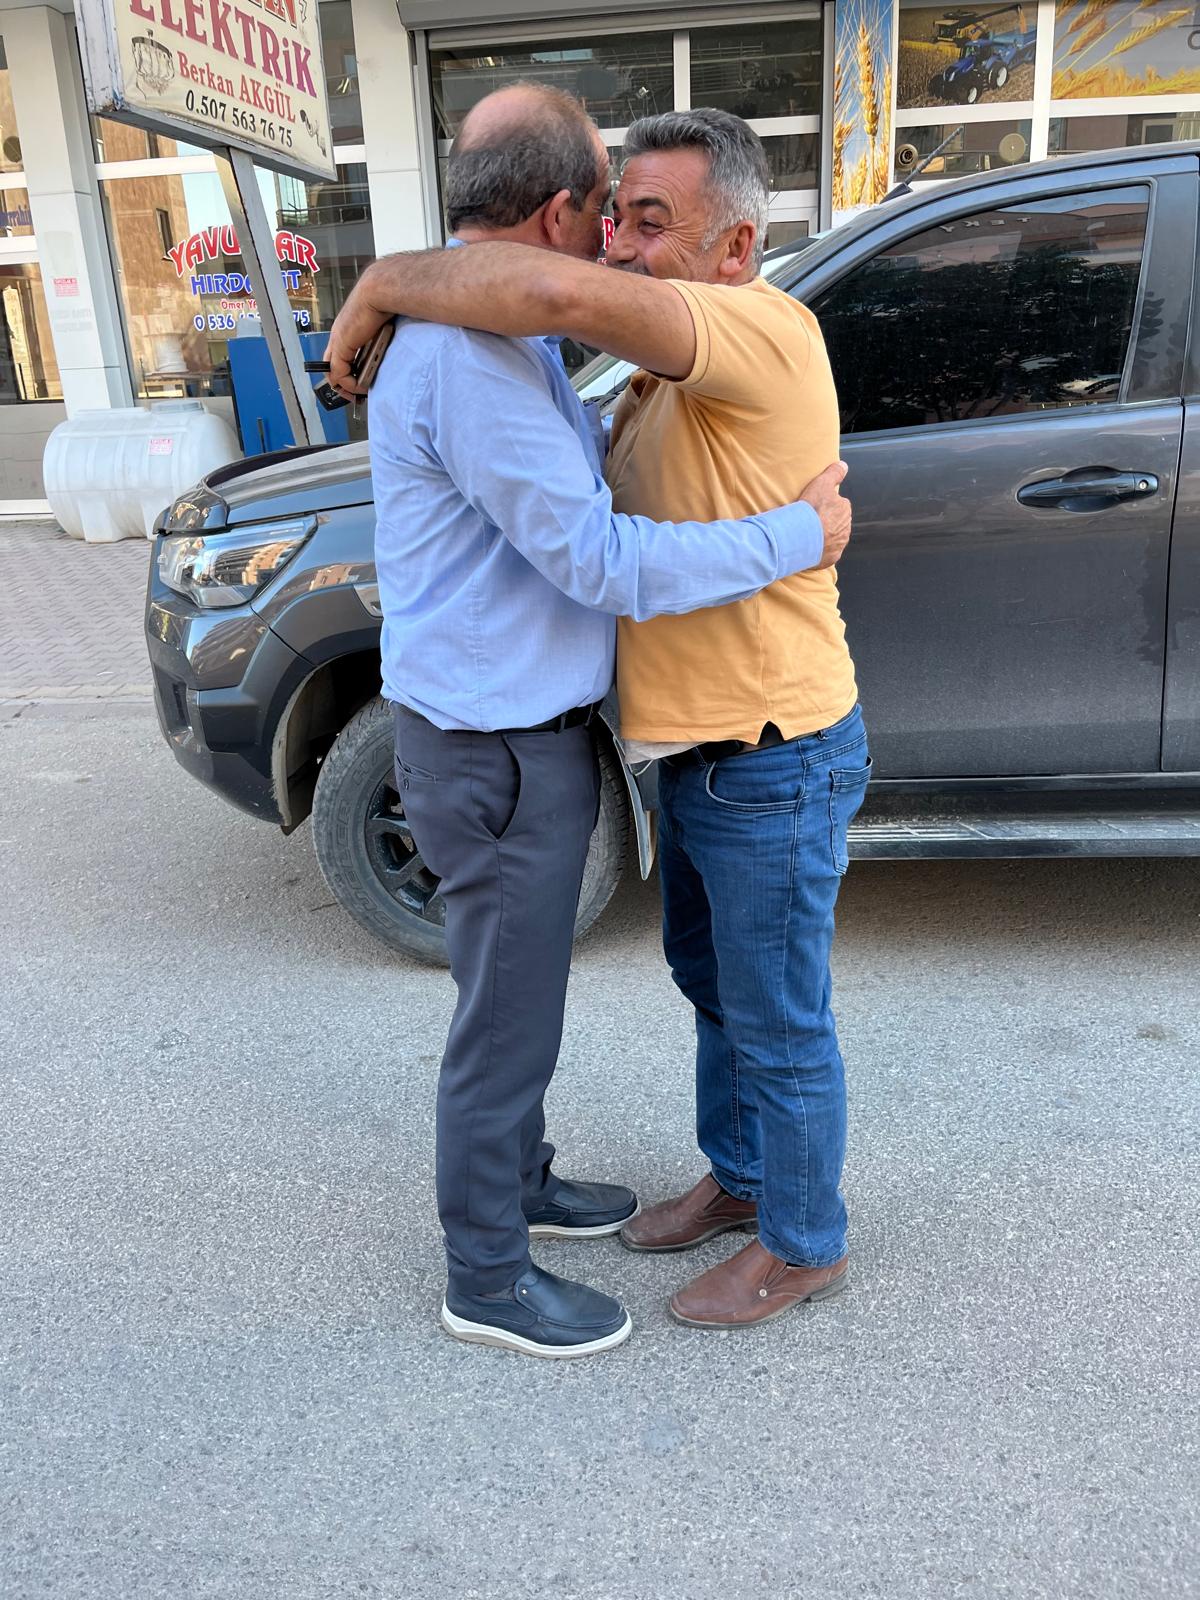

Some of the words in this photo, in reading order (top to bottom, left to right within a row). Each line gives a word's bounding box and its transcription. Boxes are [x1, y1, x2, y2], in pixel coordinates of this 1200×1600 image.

[177, 51, 235, 97] Berkan
[239, 74, 296, 123] AKGÜL
[186, 90, 227, 121] 0.507
[232, 107, 256, 133] 563
[260, 118, 275, 141] 76
[279, 126, 293, 148] 75
[168, 224, 320, 278] YAVUAR
[194, 314, 205, 331] 0
[208, 313, 236, 330] 536
